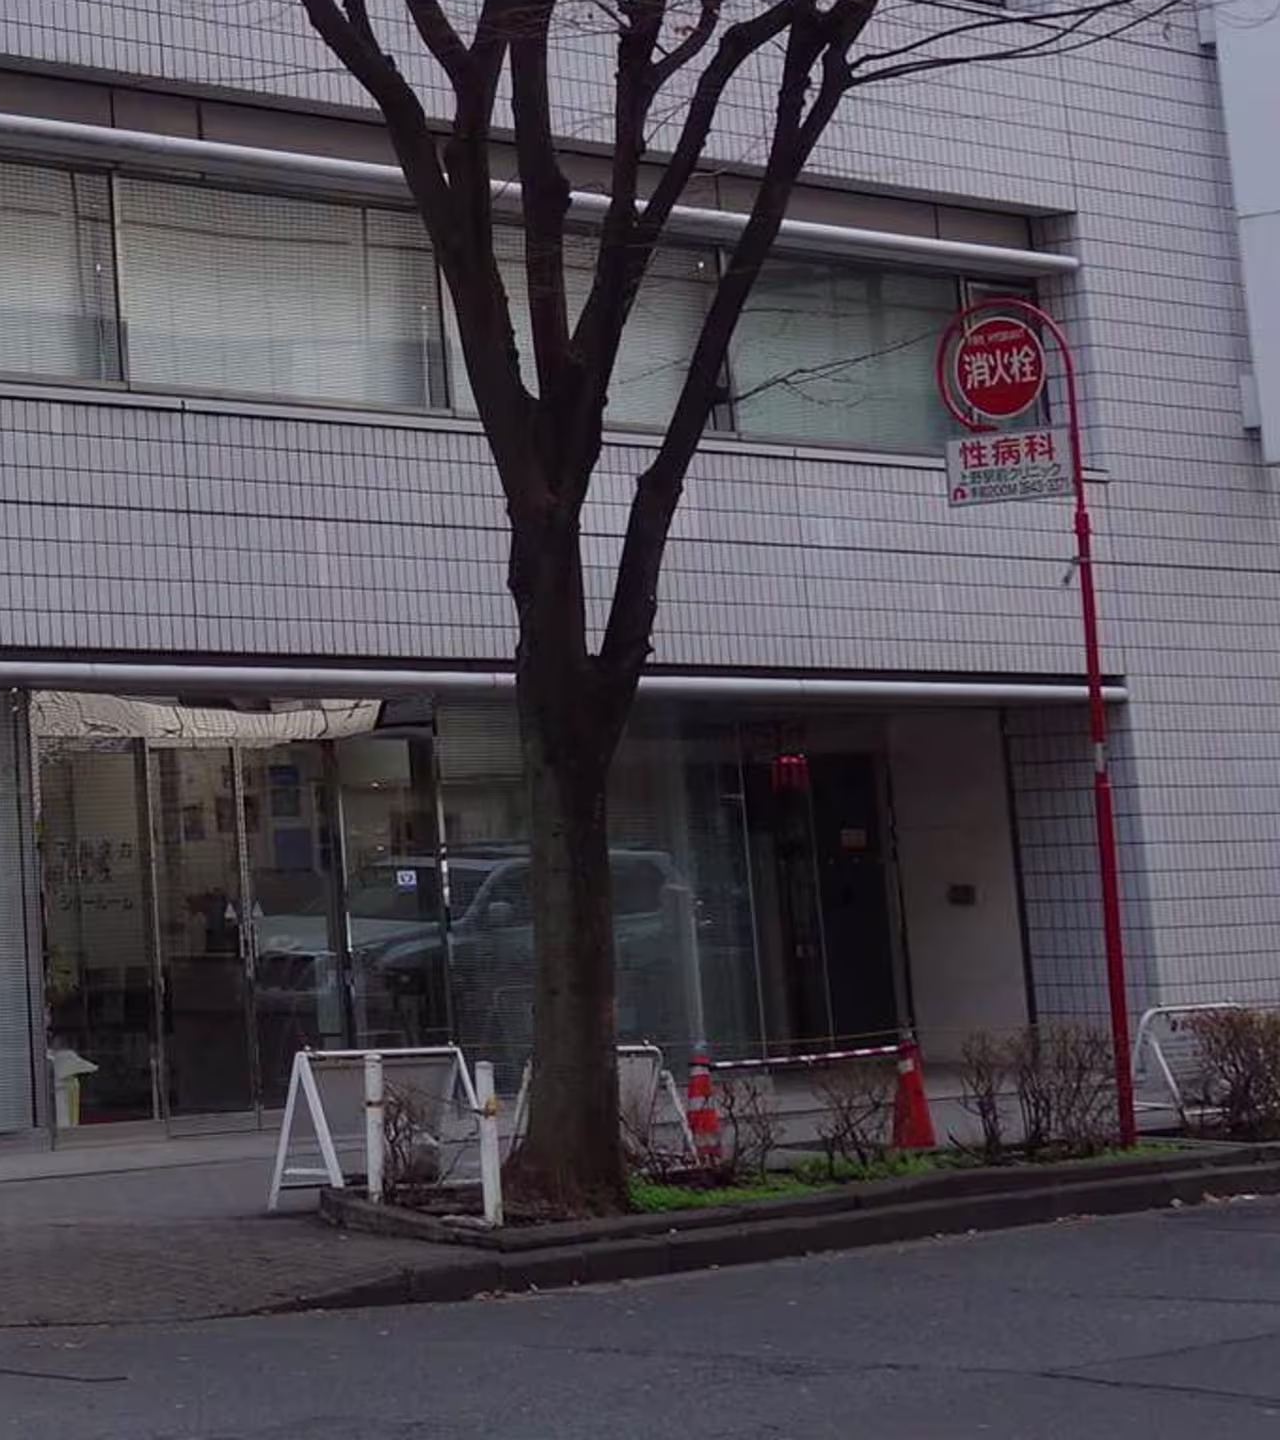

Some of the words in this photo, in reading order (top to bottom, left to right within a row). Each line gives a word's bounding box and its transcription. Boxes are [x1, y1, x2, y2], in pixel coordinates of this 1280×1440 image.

[963, 346, 1038, 389] 消火栓
[959, 433, 1055, 470] 性病科
